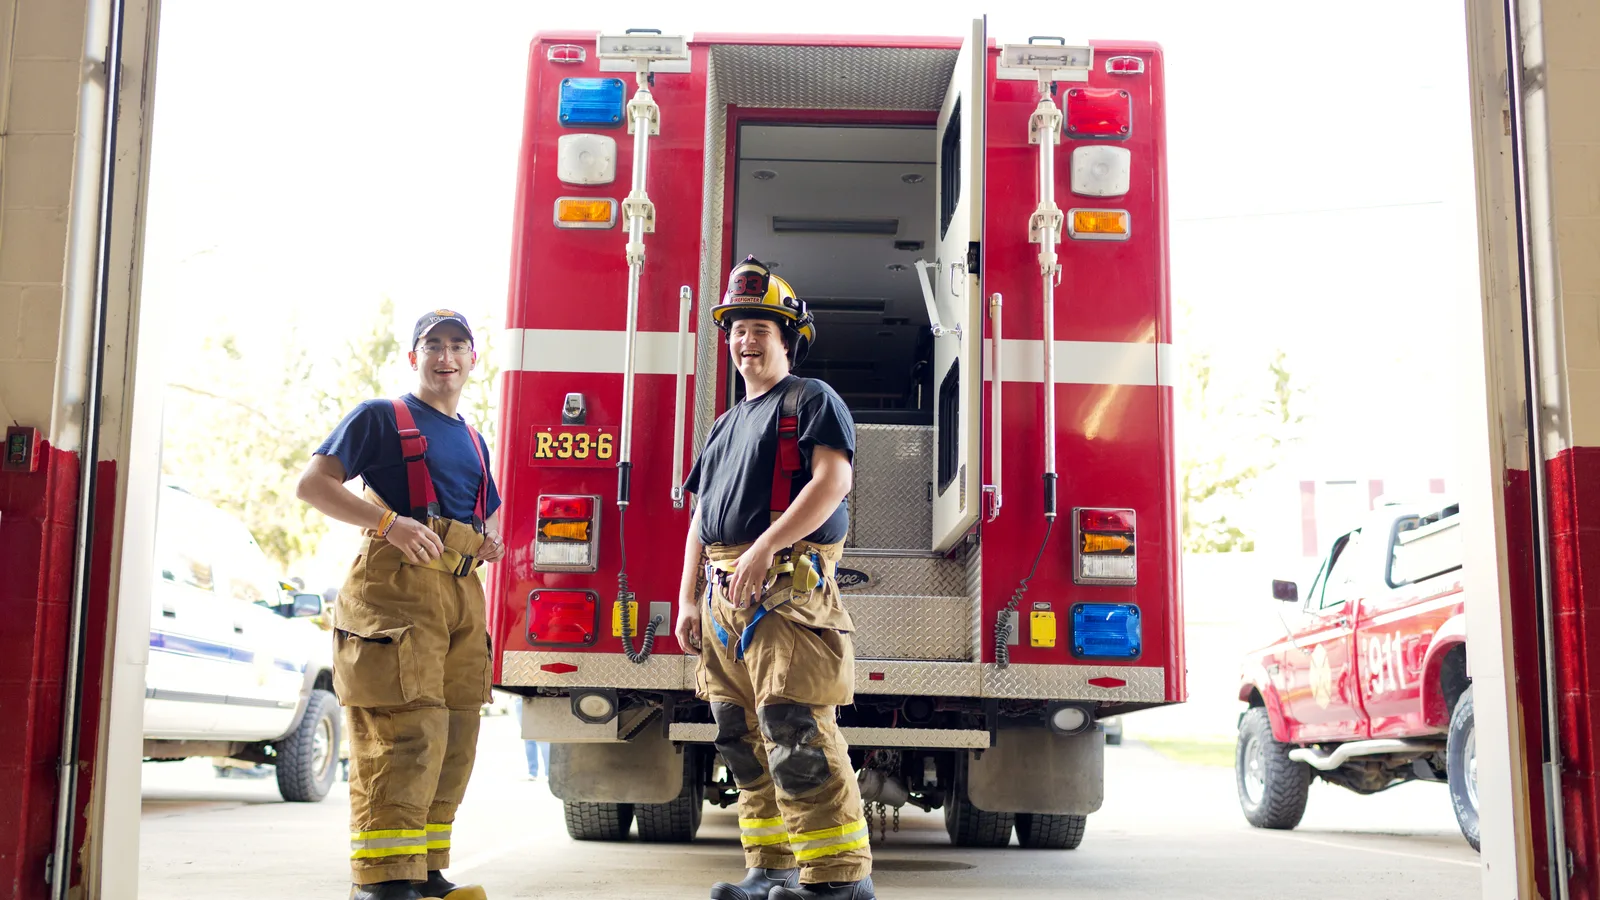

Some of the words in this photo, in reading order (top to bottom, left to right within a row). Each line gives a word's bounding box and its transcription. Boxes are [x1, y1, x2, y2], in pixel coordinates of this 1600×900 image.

[733, 275, 762, 295] 33
[534, 432, 613, 460] R-33-6
[836, 573, 859, 585] roe
